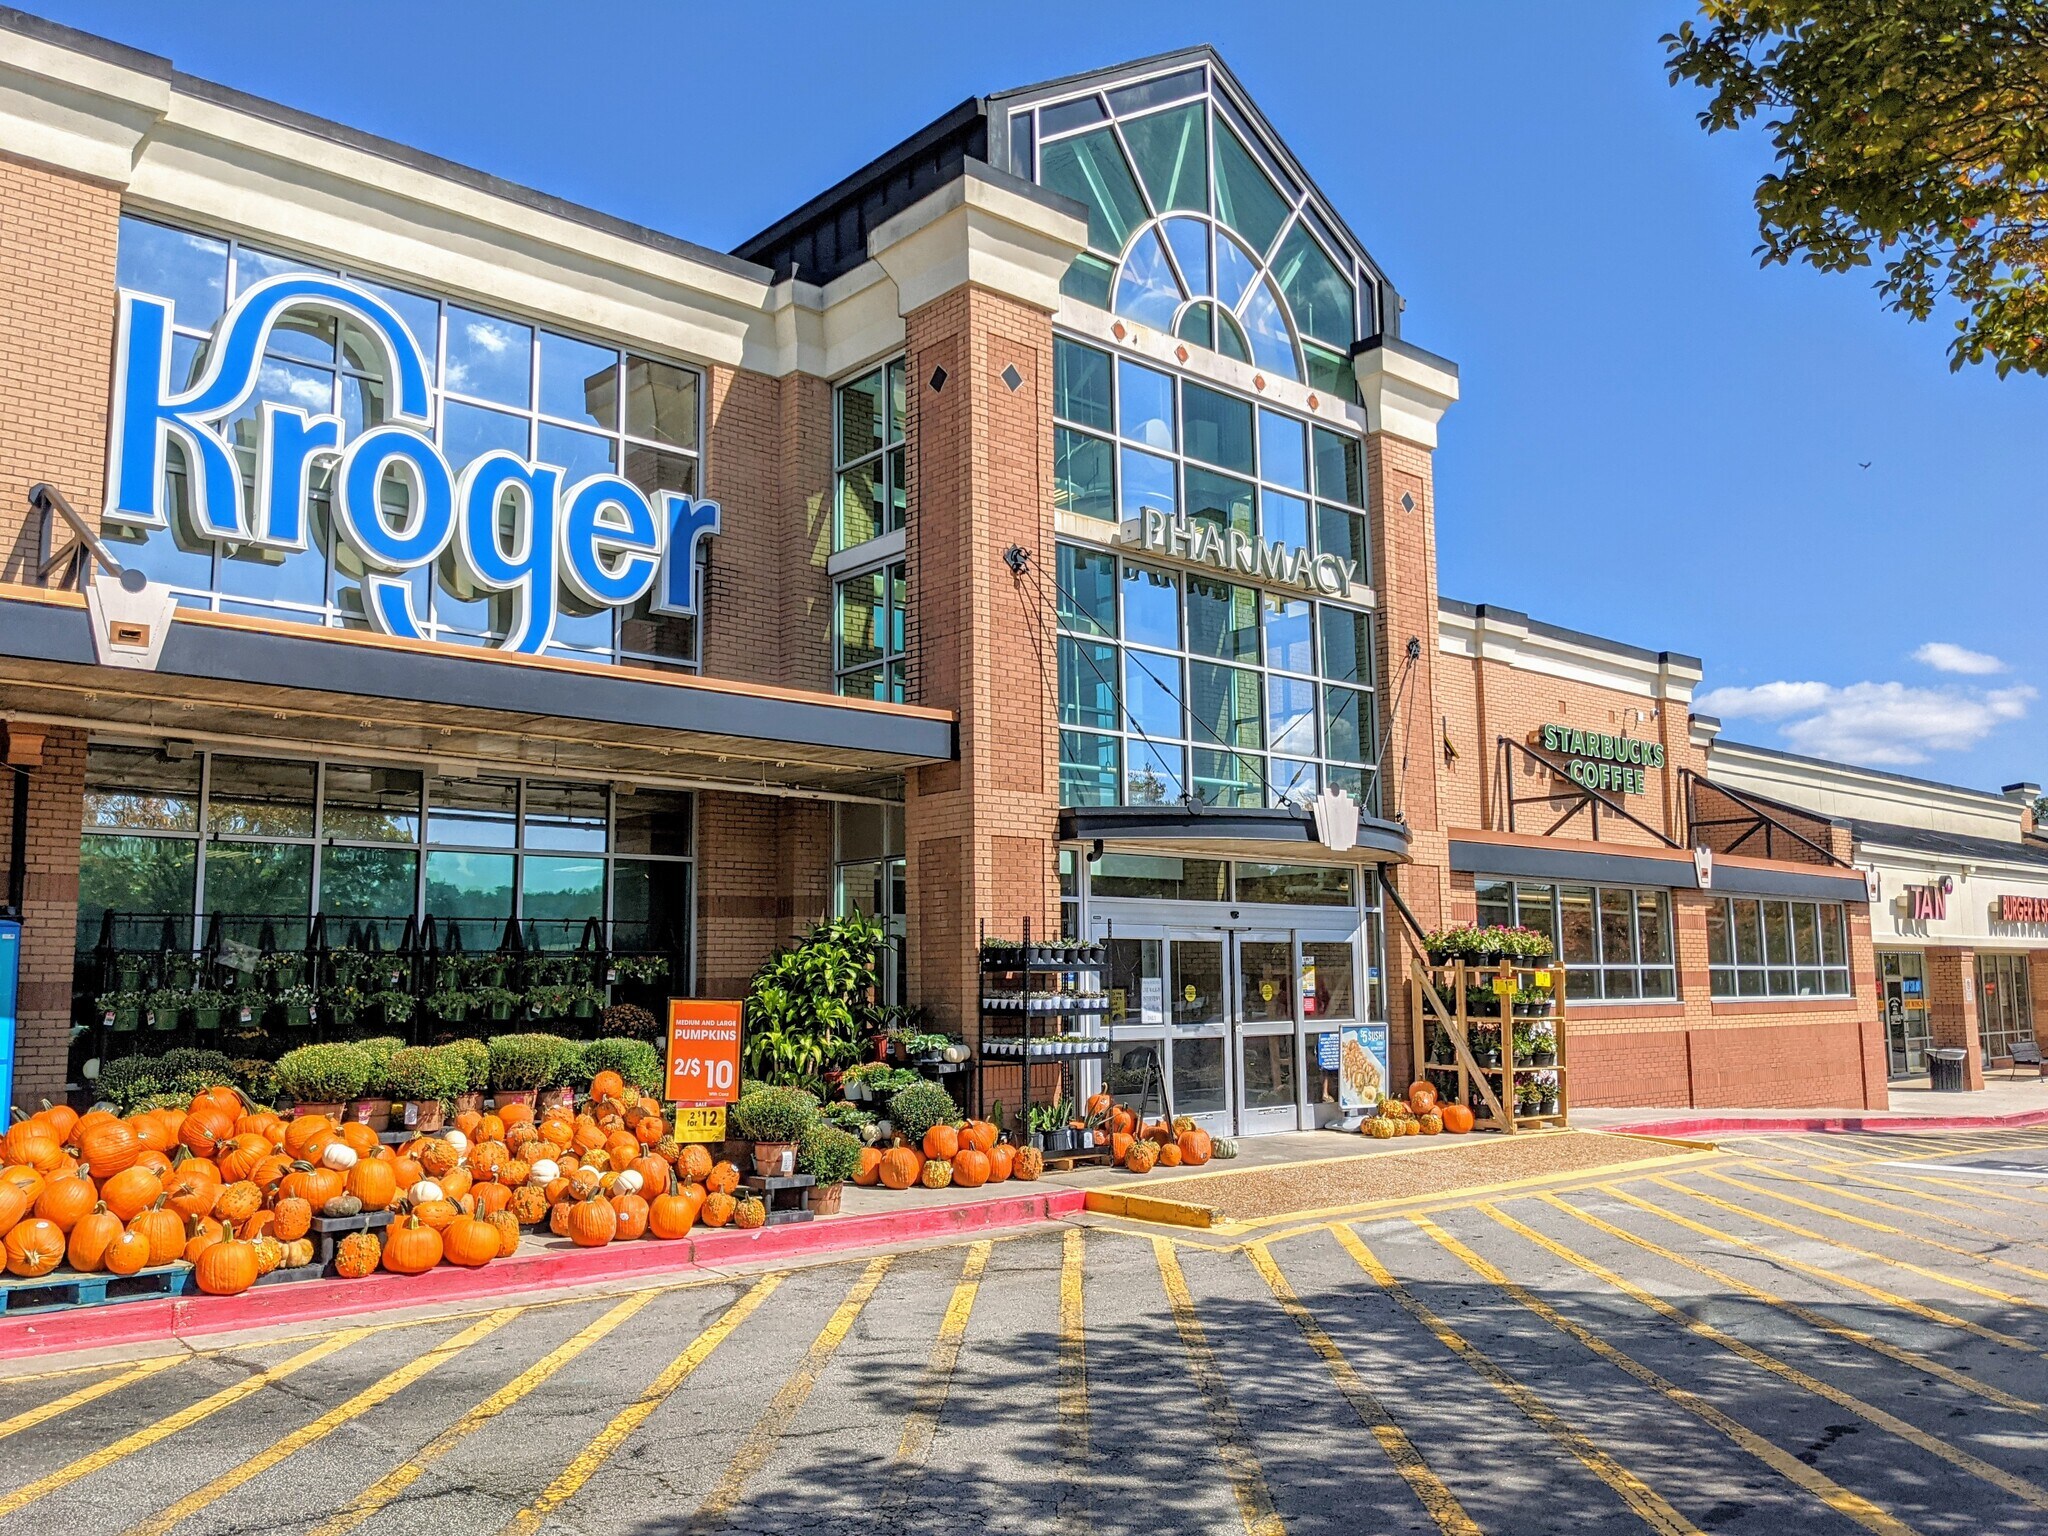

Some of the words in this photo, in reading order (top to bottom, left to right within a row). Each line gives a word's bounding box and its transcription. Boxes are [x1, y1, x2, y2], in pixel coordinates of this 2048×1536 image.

[102, 273, 721, 655] Kroger
[1140, 505, 1358, 598] PHARMACY
[1543, 722, 1665, 769] STARBUCKS
[1568, 759, 1646, 795] COFFEE
[1909, 884, 1947, 921] TAN
[2002, 895, 2033, 922] BURGER
[674, 1029, 737, 1041] PUMPKINS
[1368, 1031, 1385, 1041] SUSHI
[687, 1119, 697, 1127] for
[690, 1111, 695, 1120] 2
